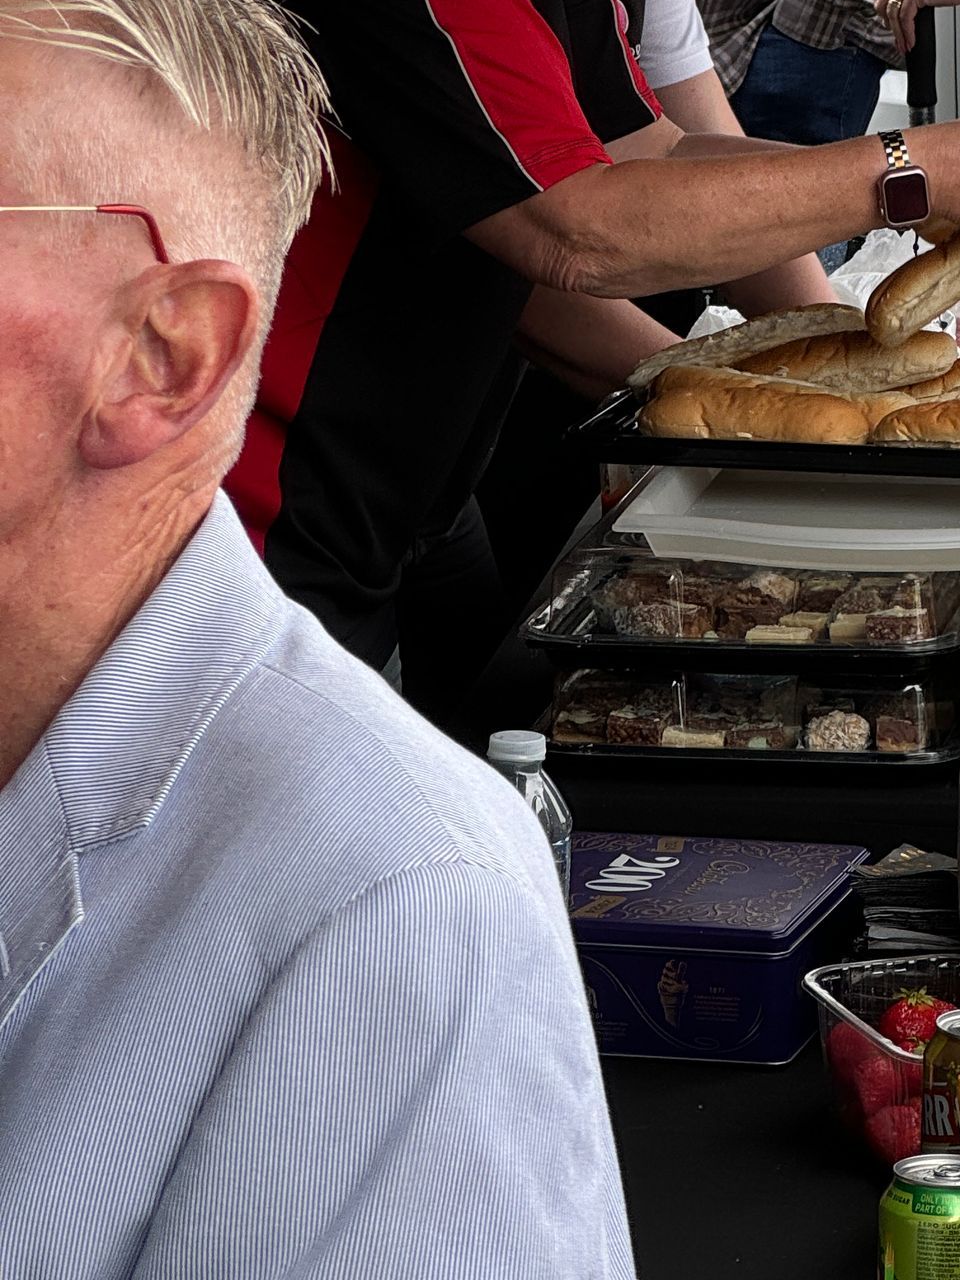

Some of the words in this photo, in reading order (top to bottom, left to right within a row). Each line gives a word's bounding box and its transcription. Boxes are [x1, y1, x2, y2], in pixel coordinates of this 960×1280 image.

[585, 853, 680, 892] 200
[920, 1194, 938, 1203] ONLY
[914, 1204, 935, 1213] PART
[936, 1206, 946, 1214] OF
[918, 1221, 939, 1229] ZERO
